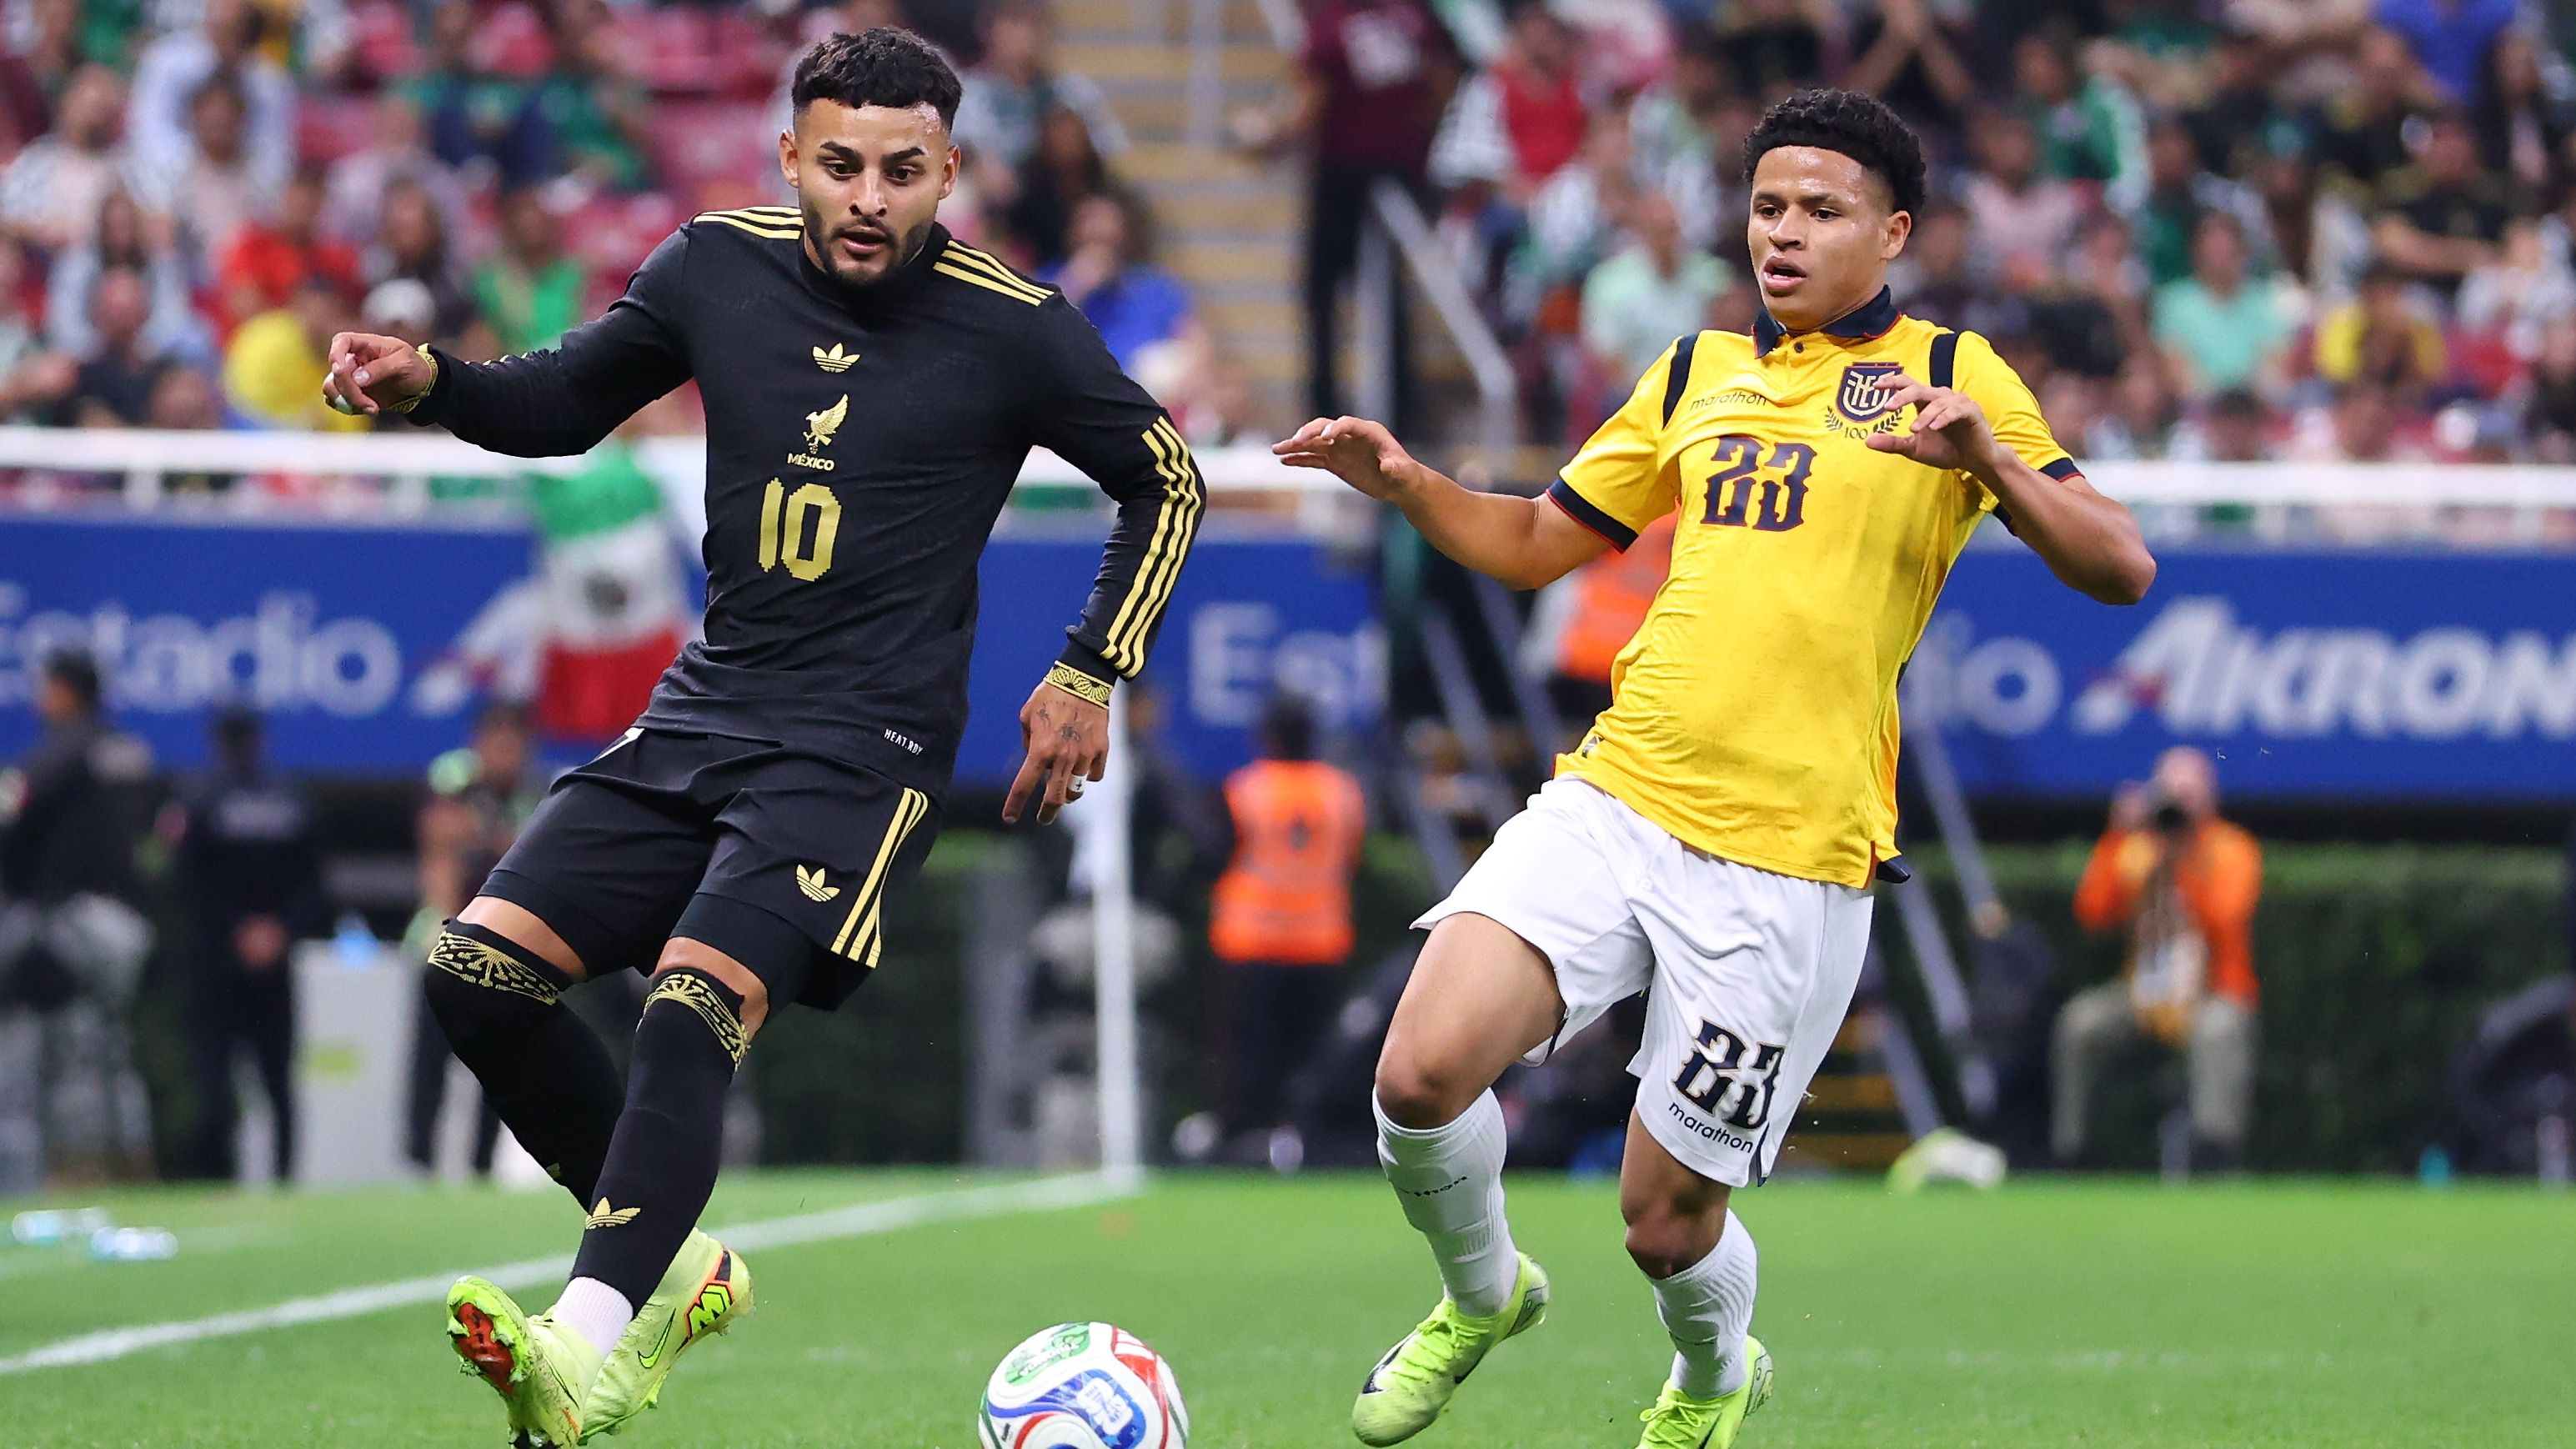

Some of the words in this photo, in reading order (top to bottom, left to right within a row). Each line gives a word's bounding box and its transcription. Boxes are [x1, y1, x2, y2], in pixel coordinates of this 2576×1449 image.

[1690, 389, 1767, 411] marathon
[1843, 426, 1868, 440] 100
[786, 452, 835, 471] MÉXICO
[1699, 434, 1818, 532] 23
[758, 476, 843, 583] 10
[884, 728, 924, 755] HEAT.RDY
[1672, 1016, 1786, 1131] 23
[1668, 1101, 1754, 1154] marathon
